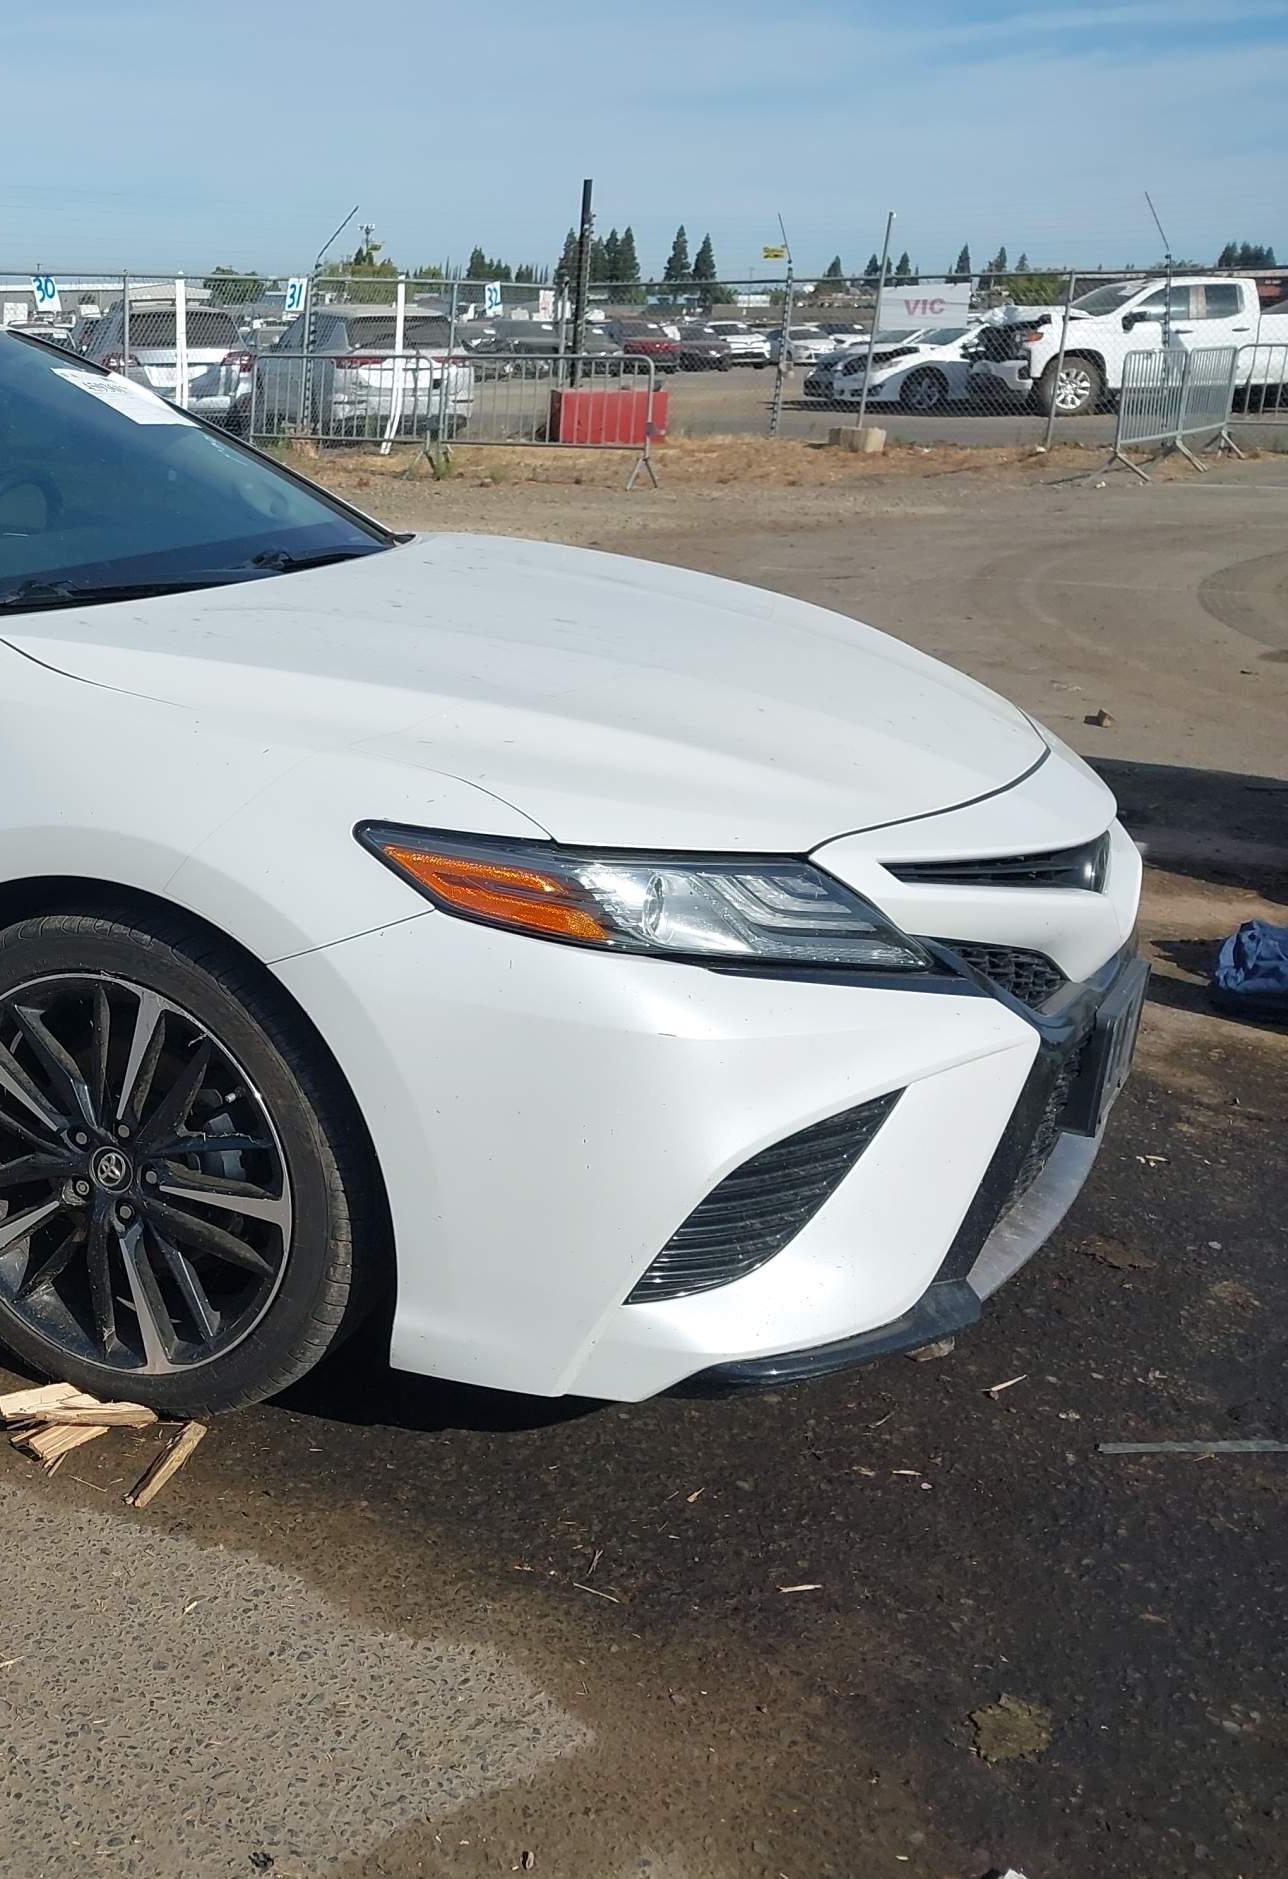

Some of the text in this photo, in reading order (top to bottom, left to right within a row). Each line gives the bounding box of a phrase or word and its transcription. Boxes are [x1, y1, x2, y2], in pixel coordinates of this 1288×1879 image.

[32, 275, 56, 303] 30
[287, 283, 303, 309] 31
[487, 287, 502, 309] 32
[903, 298, 946, 316] VIC
